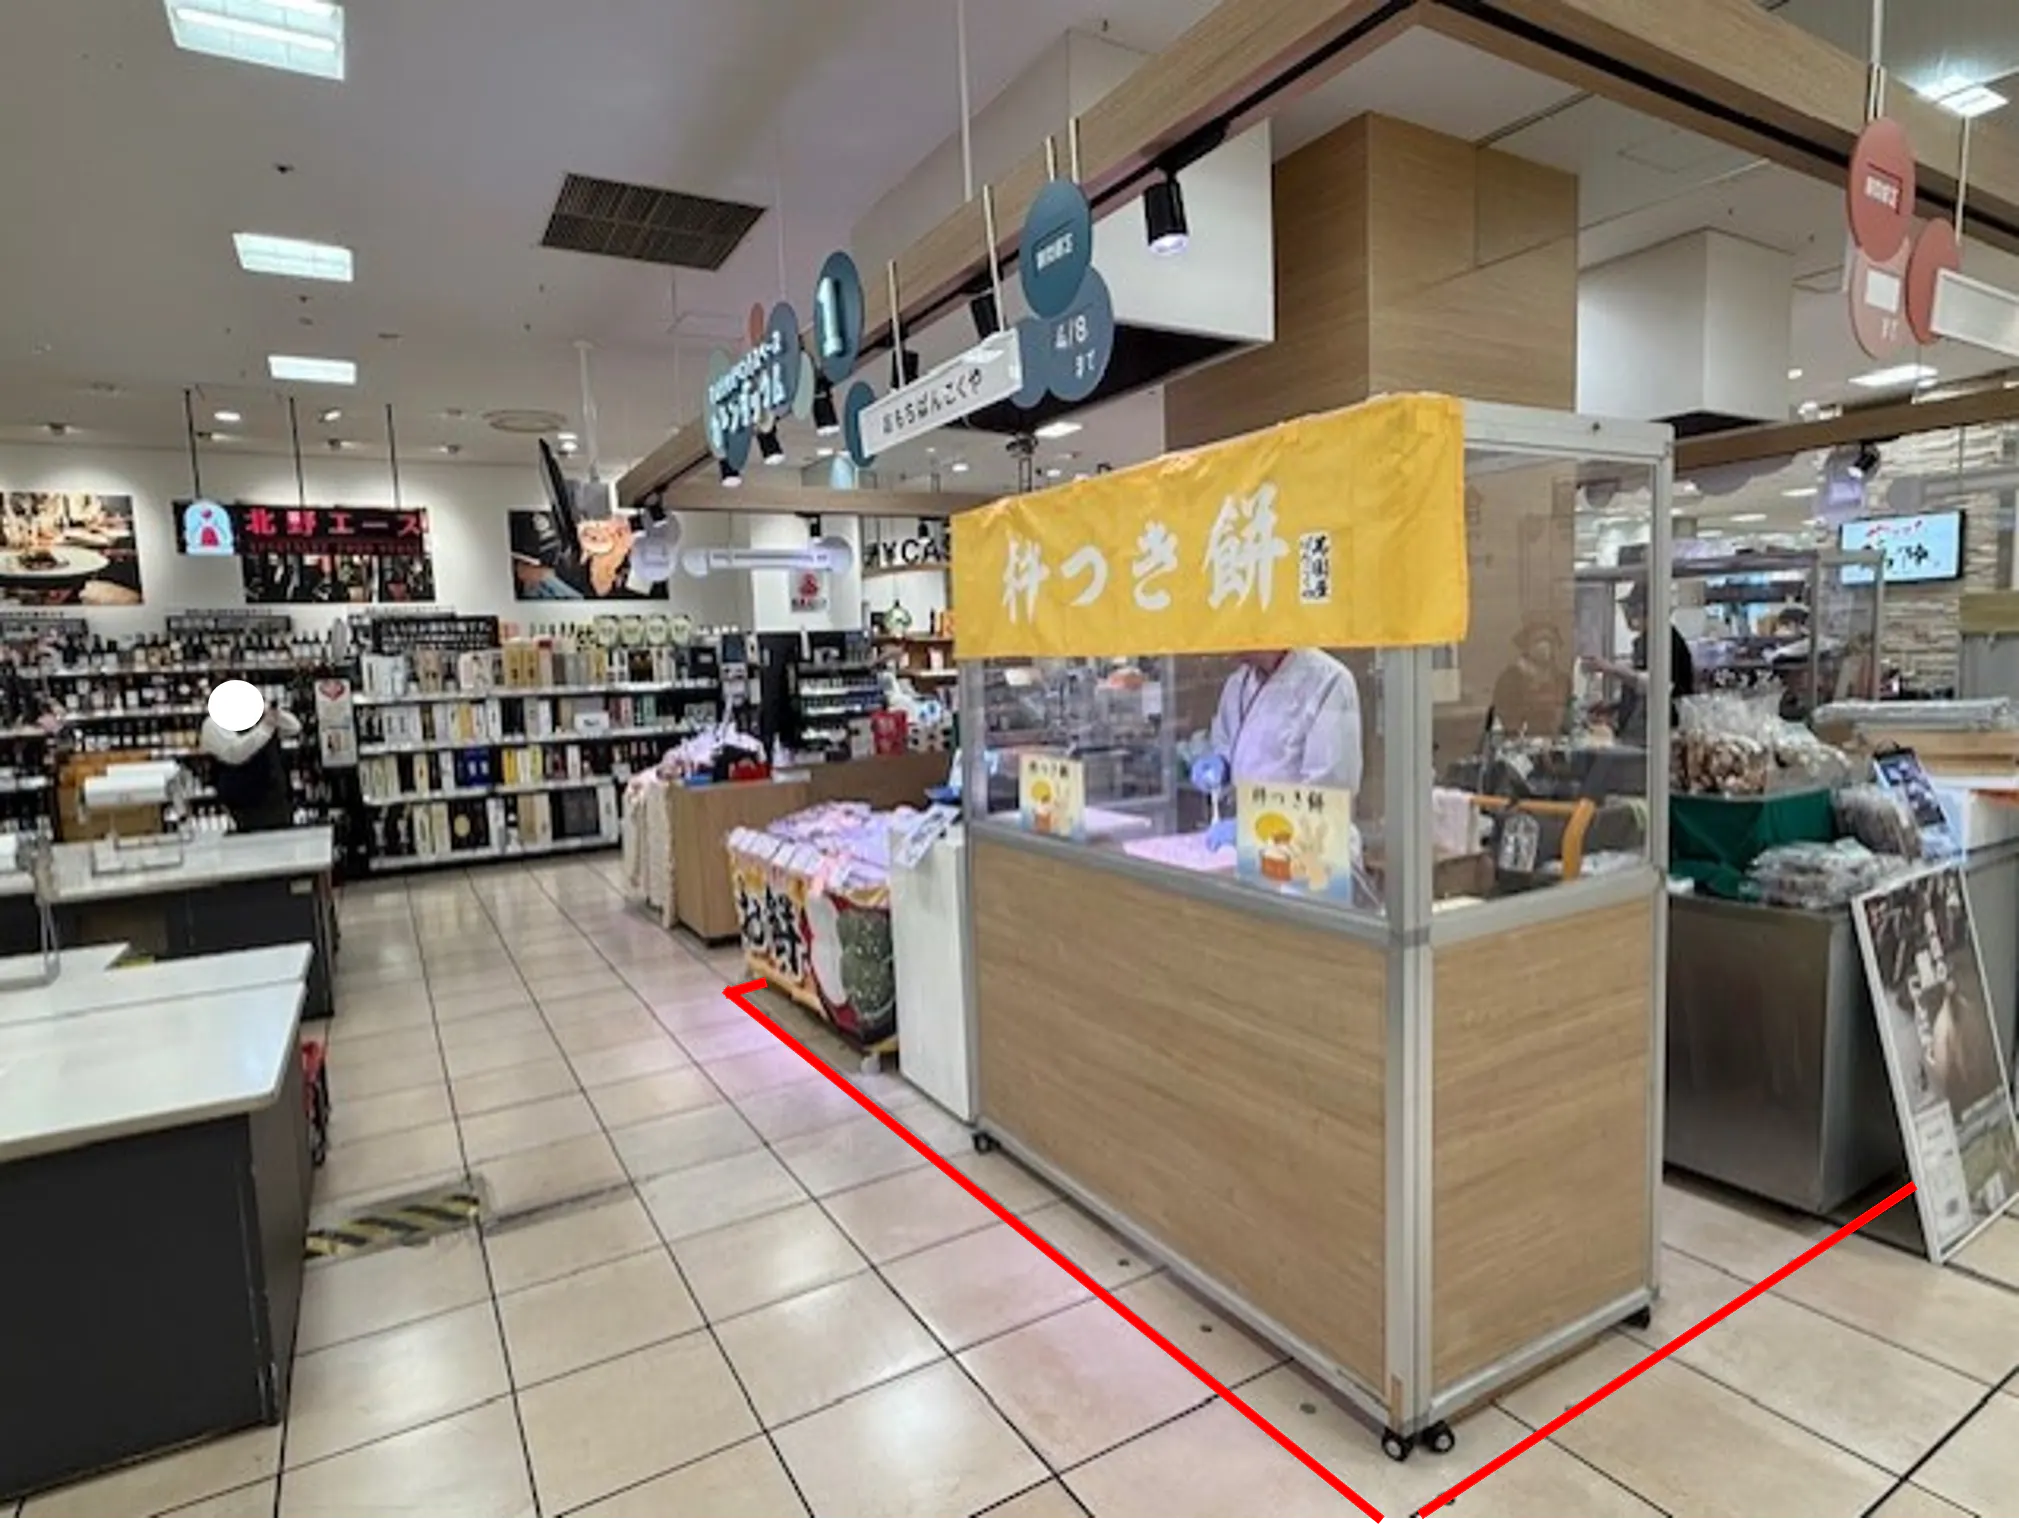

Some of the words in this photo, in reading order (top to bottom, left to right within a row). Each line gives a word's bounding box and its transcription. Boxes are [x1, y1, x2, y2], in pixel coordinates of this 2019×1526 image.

[1055, 314, 1088, 349] 4/8
[245, 507, 421, 537] 北野エース
